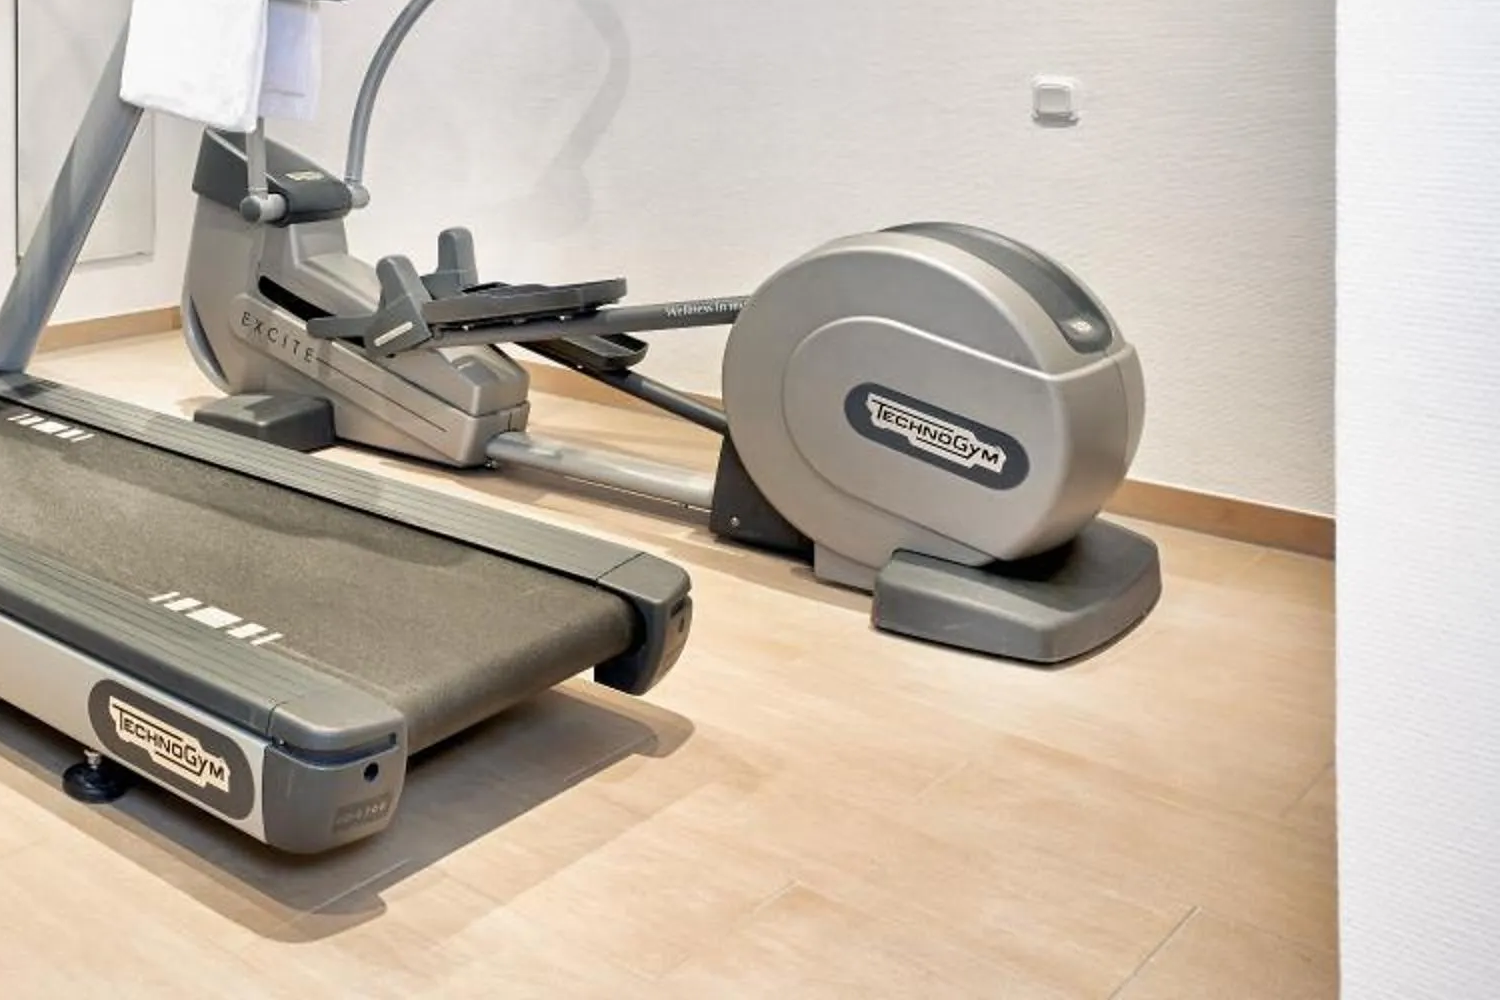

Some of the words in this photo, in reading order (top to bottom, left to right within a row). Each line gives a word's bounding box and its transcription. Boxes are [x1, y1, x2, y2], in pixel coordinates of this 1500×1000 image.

[241, 311, 315, 363] EXCITE
[872, 399, 1000, 465] TECHNOGYM
[111, 703, 225, 782] TECHNOGYM
